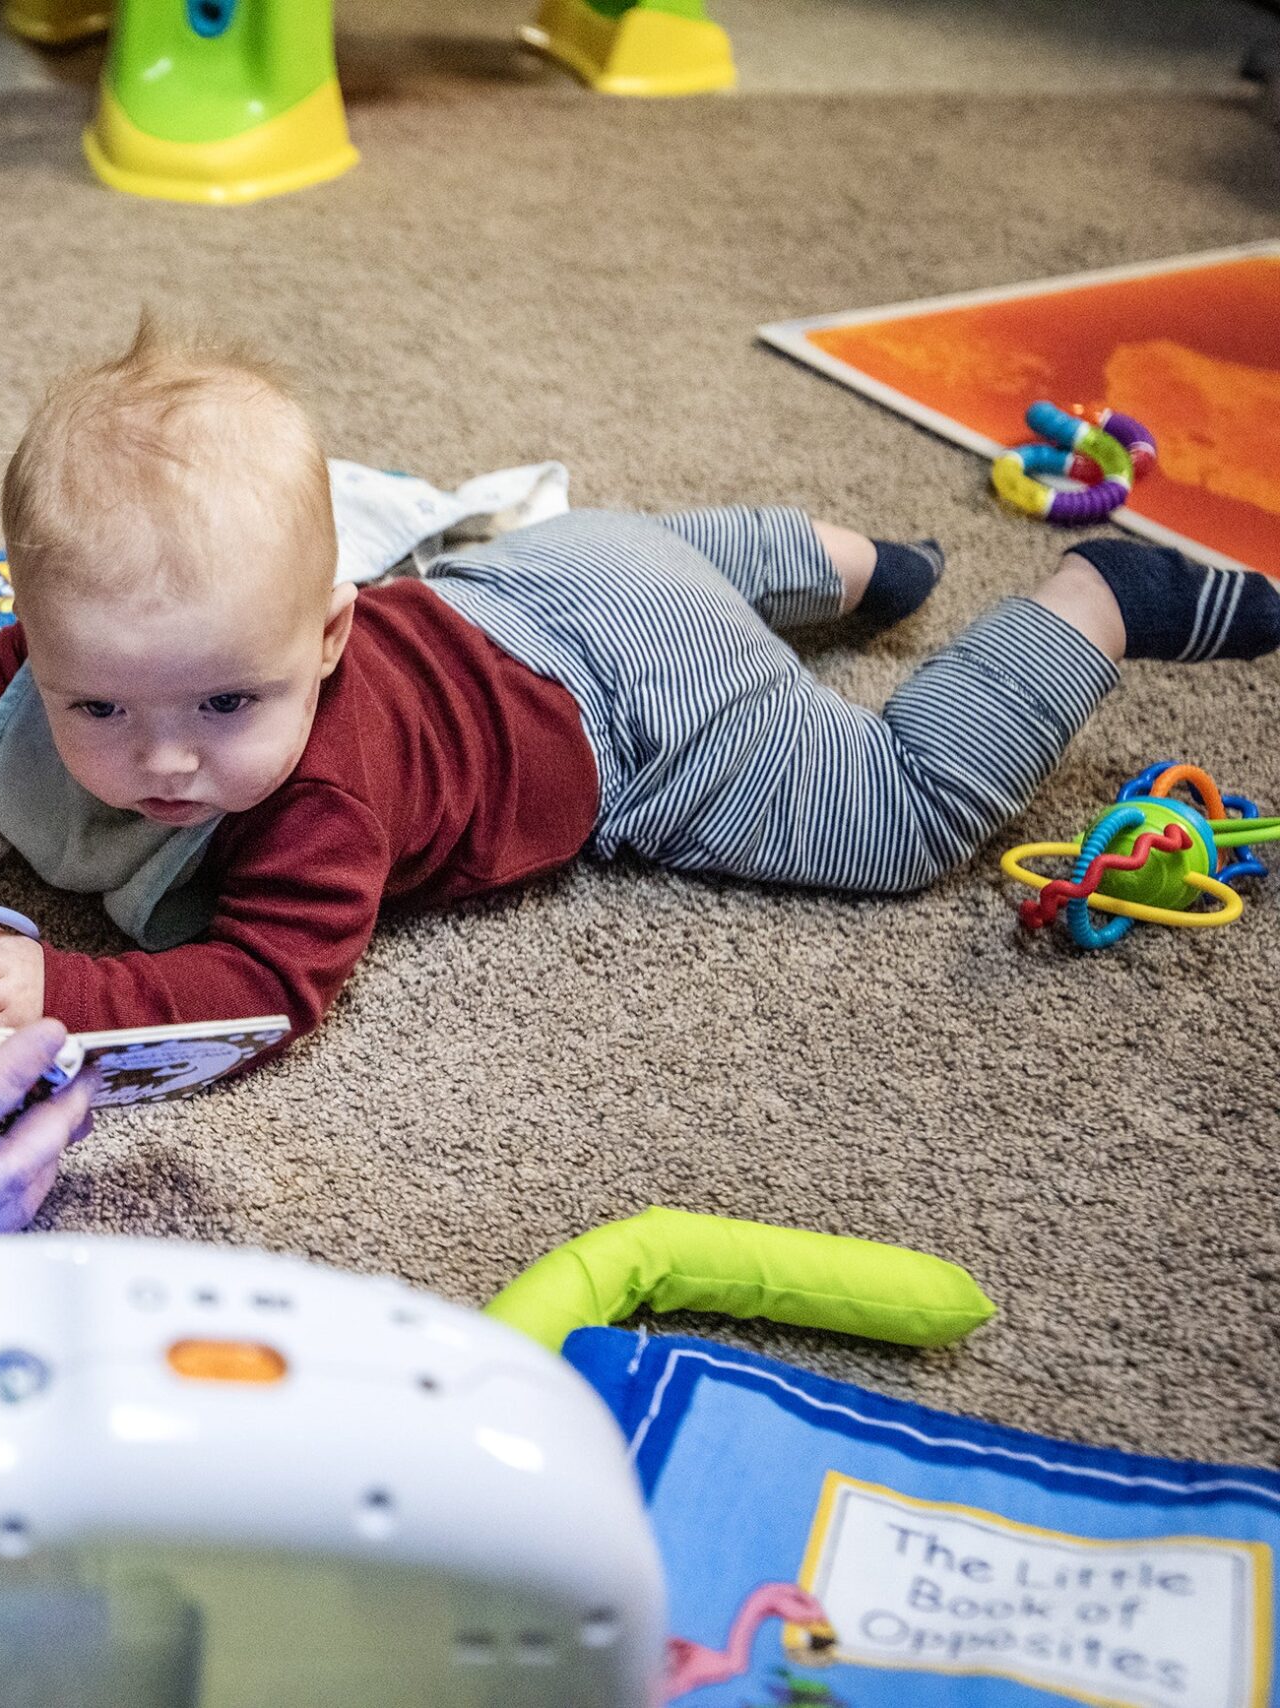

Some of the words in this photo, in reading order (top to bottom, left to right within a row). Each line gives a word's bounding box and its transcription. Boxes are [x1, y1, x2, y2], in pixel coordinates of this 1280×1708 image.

[887, 1521, 995, 1584] The
[1016, 1555, 1196, 1598] Little
[907, 1575, 1054, 1621] Book
[1075, 1596, 1142, 1633] of
[858, 1607, 1188, 1694] Opposites
